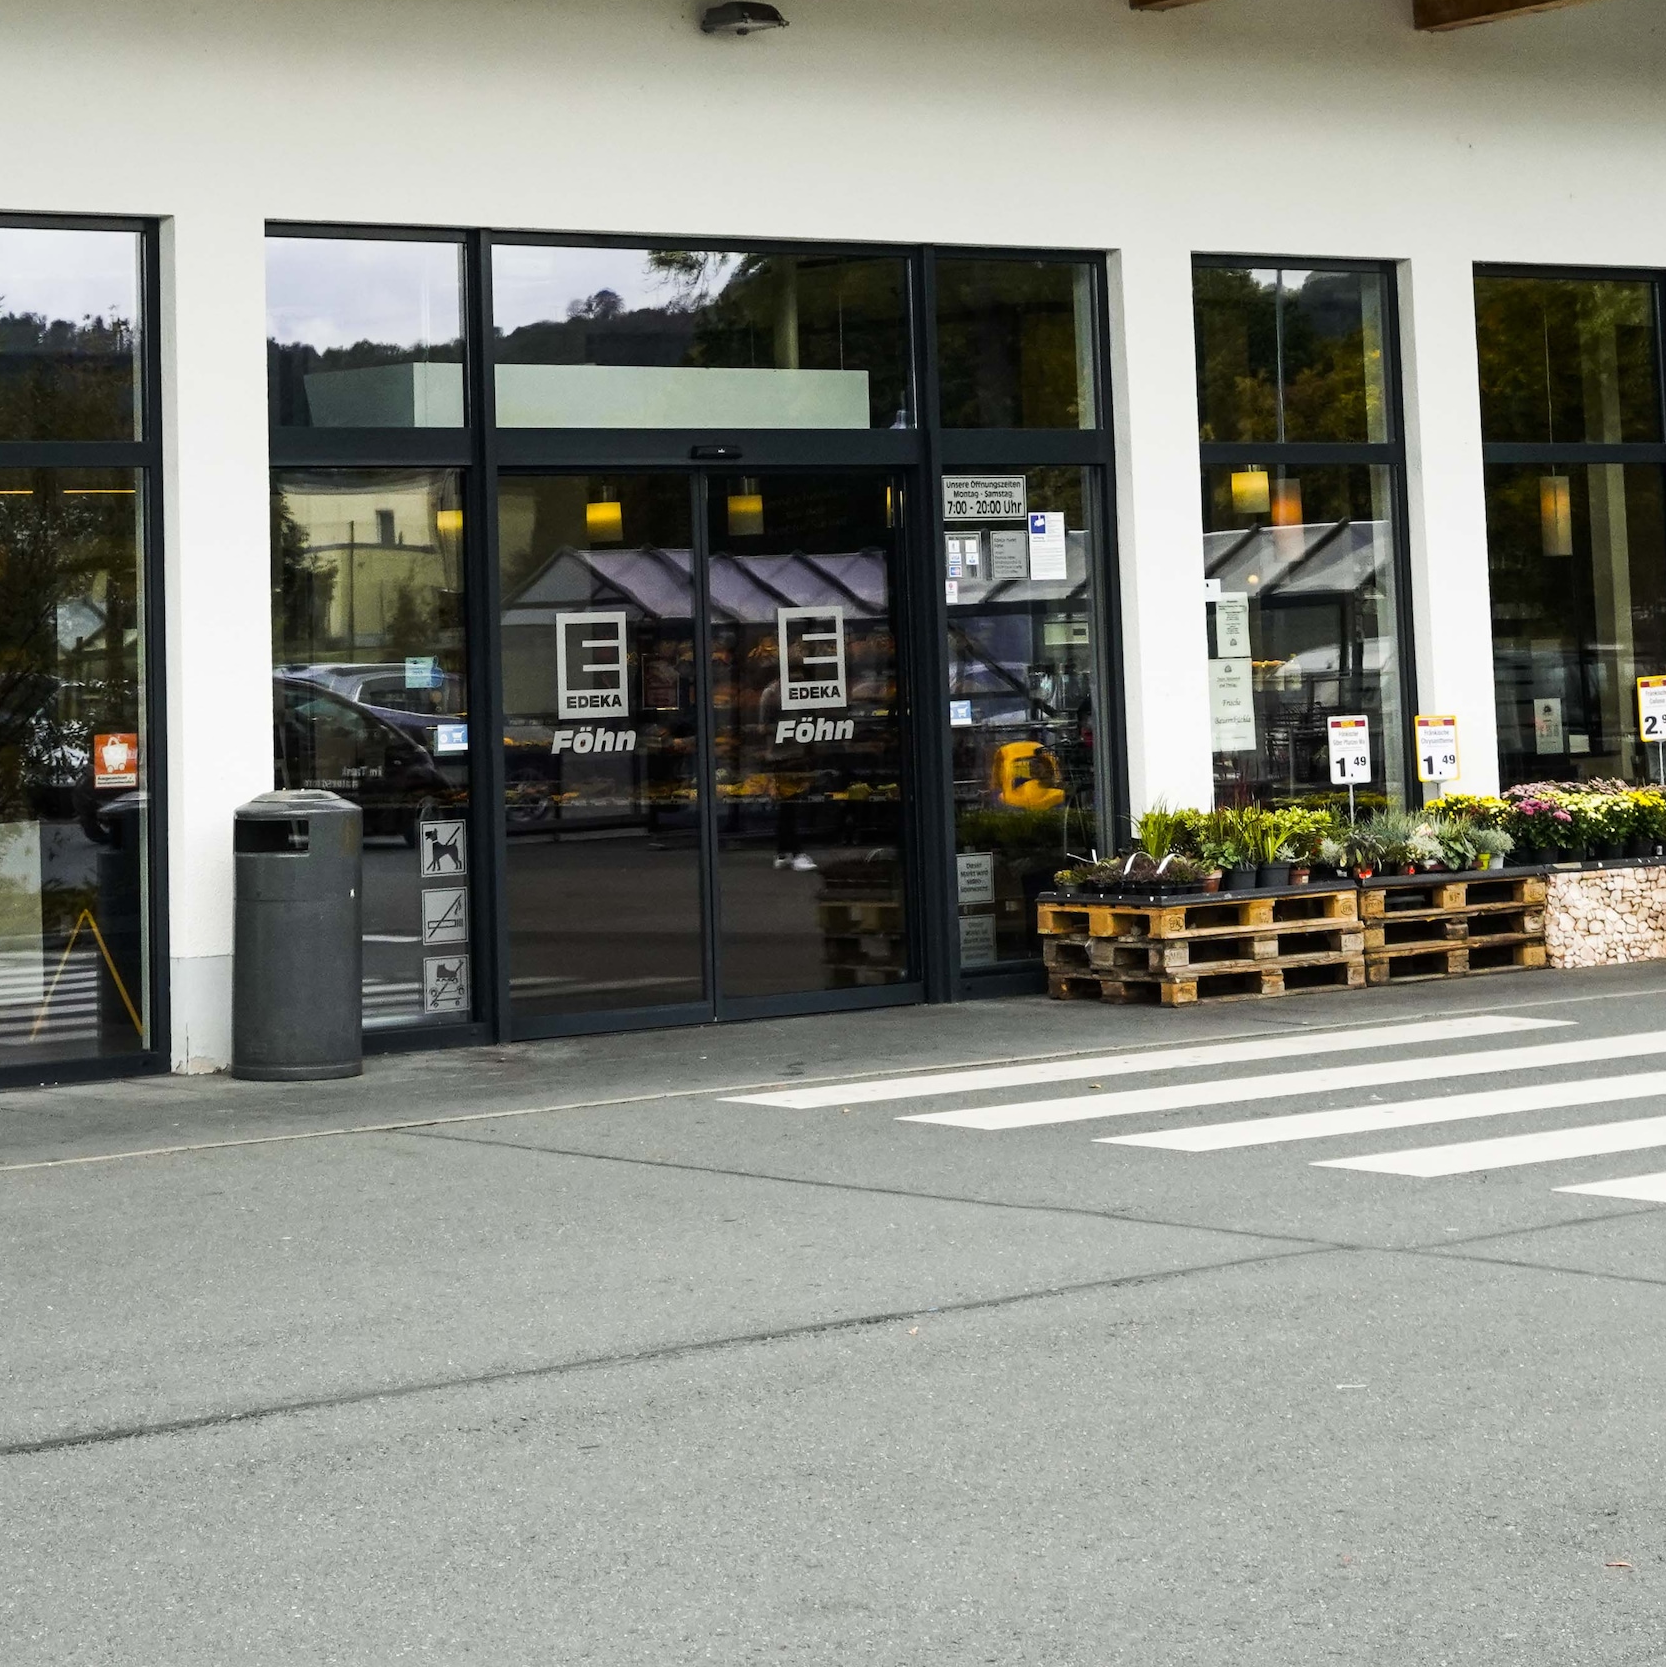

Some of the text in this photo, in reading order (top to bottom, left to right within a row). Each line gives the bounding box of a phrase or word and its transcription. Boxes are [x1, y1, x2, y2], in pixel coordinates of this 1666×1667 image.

[946, 480, 1021, 489] Unsere Öffnungszeiten
[953, 490, 979, 498] Montag
[947, 500, 967, 514] 7:00
[976, 500, 1001, 514] 20:00
[1004, 499, 1022, 514] Uhr
[788, 685, 841, 701] EDEKA
[566, 694, 622, 710] EDEKA
[775, 717, 855, 744] Föhn
[551, 726, 636, 755] Föhn
